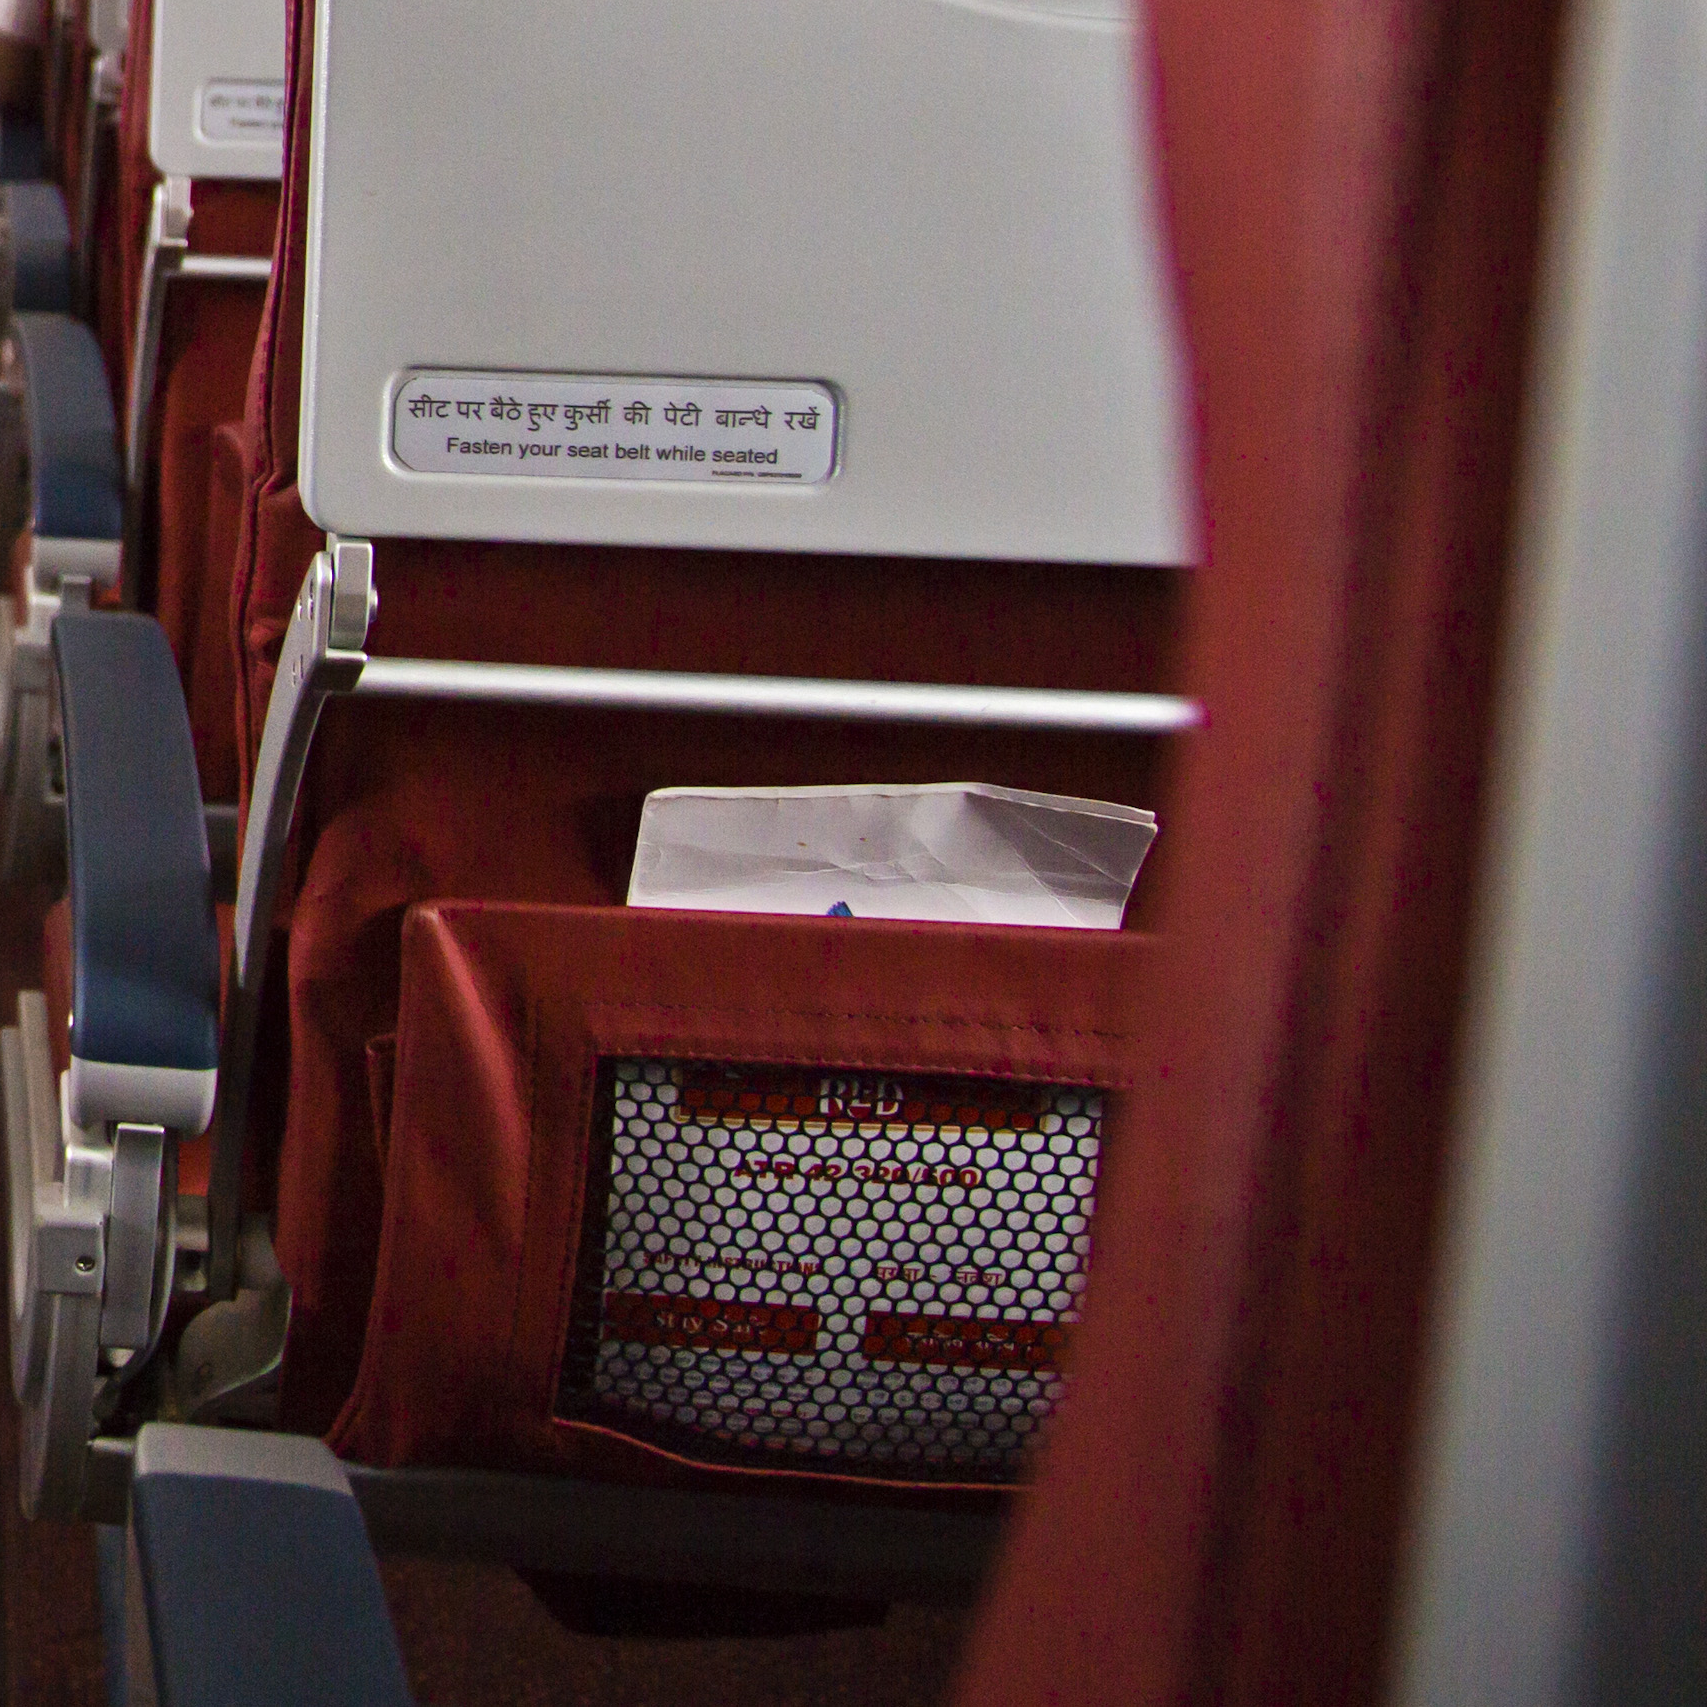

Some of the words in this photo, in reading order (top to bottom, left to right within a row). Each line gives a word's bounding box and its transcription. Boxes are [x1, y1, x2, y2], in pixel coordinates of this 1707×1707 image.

[409, 394, 451, 418] सीट
[456, 401, 485, 420] पर
[489, 396, 523, 420] बैठे
[528, 404, 559, 431] हुए
[564, 399, 611, 431] कुर्सी
[623, 401, 652, 424] की
[664, 402, 702, 426] पेटी
[784, 407, 820, 430] रखें
[447, 437, 512, 455] Fasten
[519, 444, 561, 459] your
[567, 444, 608, 458] seat
[615, 443, 650, 459] belt
[656, 445, 706, 462] while
[712, 449, 777, 464] seated
